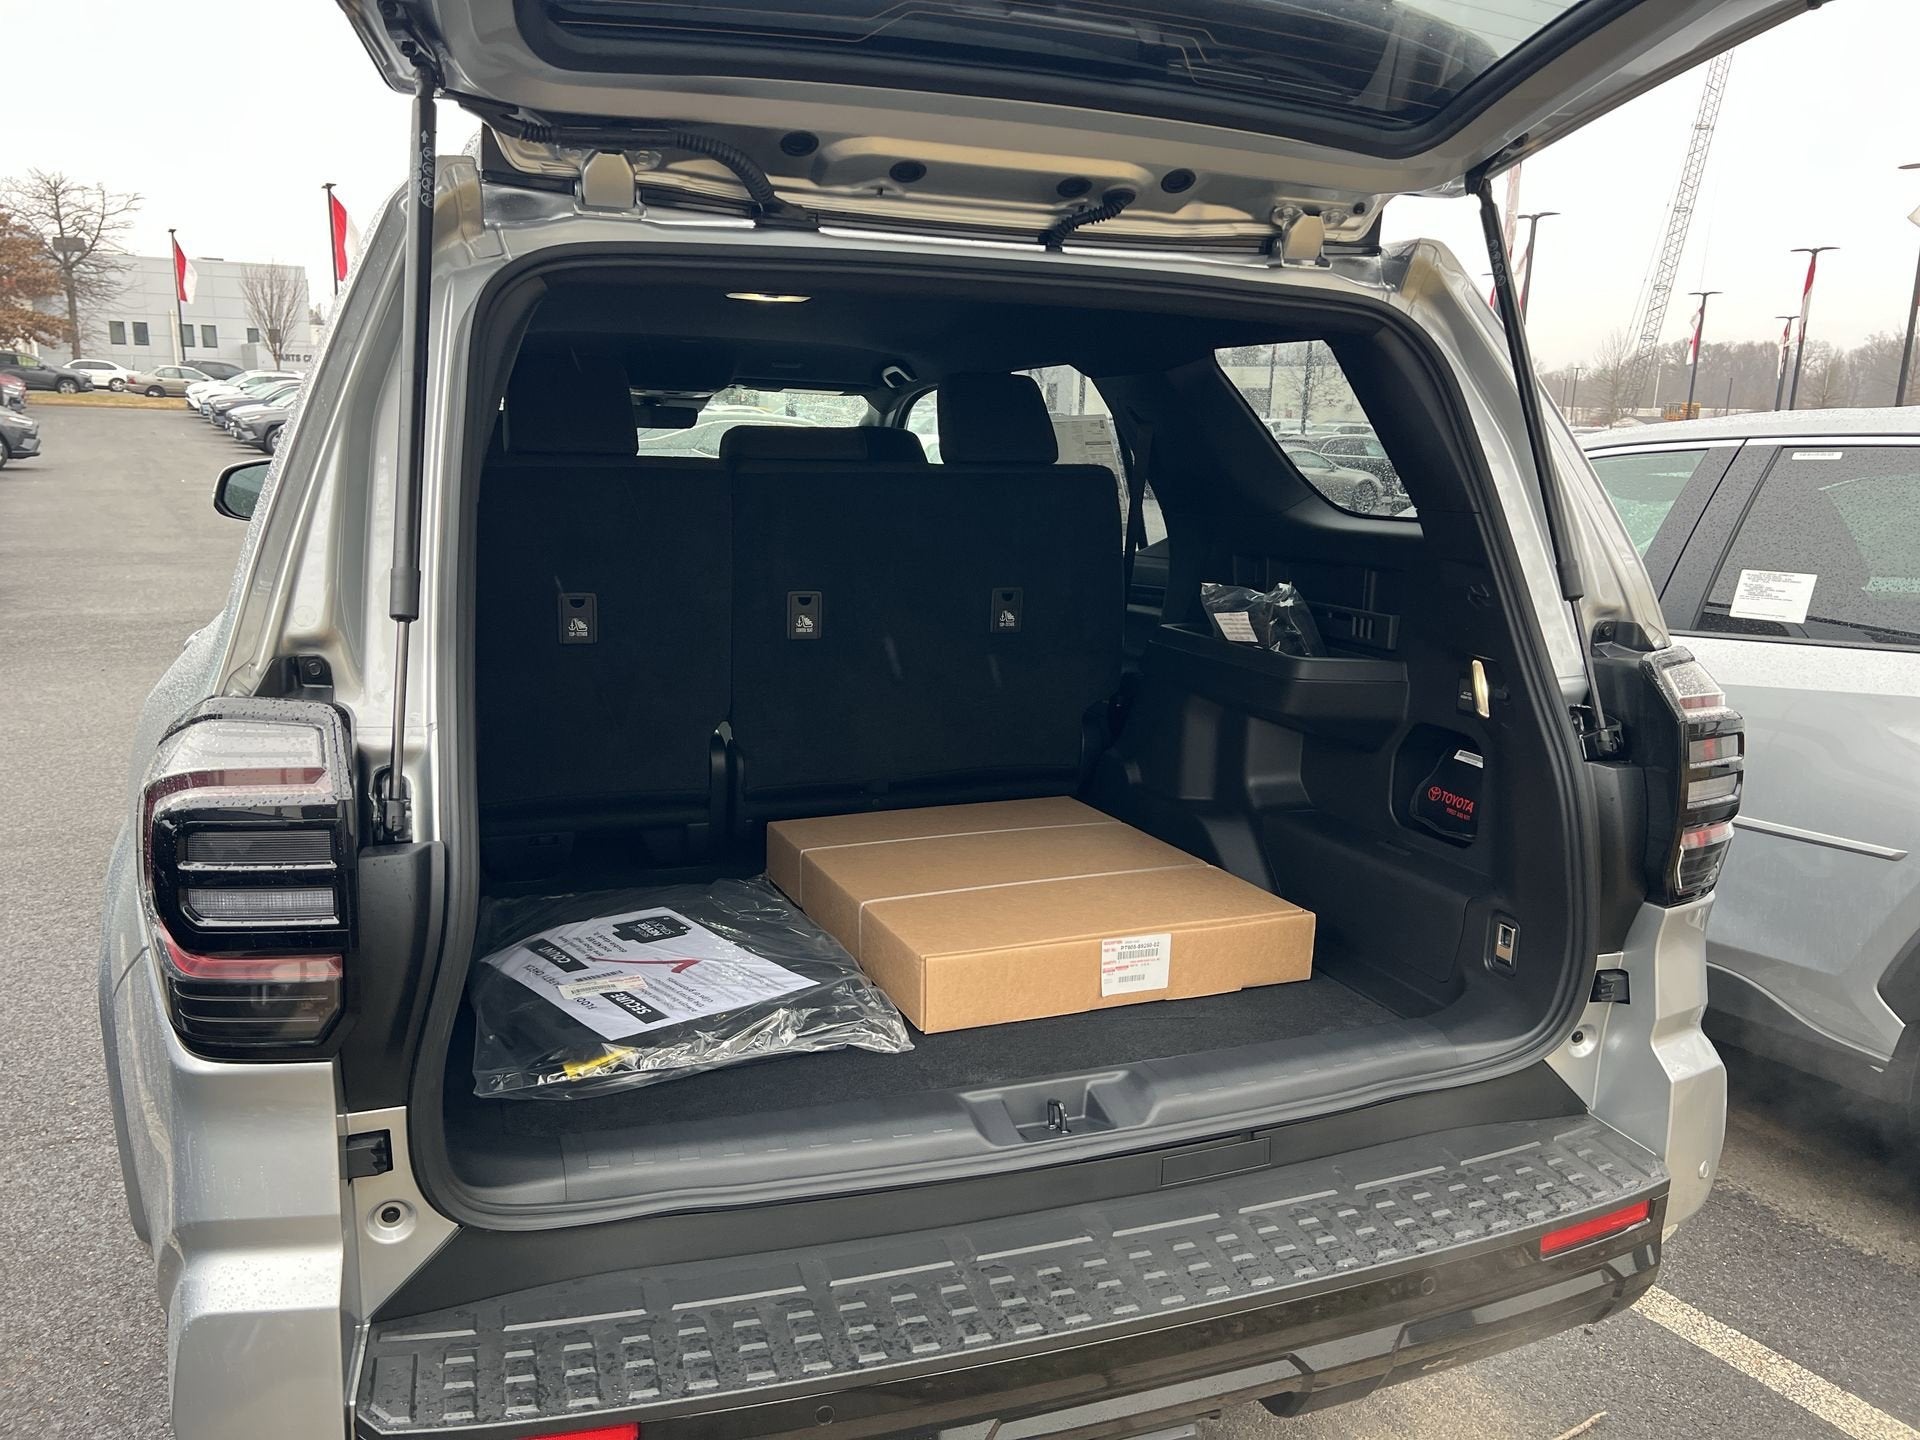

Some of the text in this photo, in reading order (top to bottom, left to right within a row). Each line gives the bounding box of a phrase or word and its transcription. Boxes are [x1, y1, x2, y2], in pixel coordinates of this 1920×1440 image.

[1441, 790, 1474, 814] TOYOTA
[637, 922, 663, 937] NEVER
[541, 945, 572, 964] COUNT
[522, 964, 545, 977] CHECK
[541, 973, 561, 990] AFETY
[610, 992, 652, 1015] SECURE
